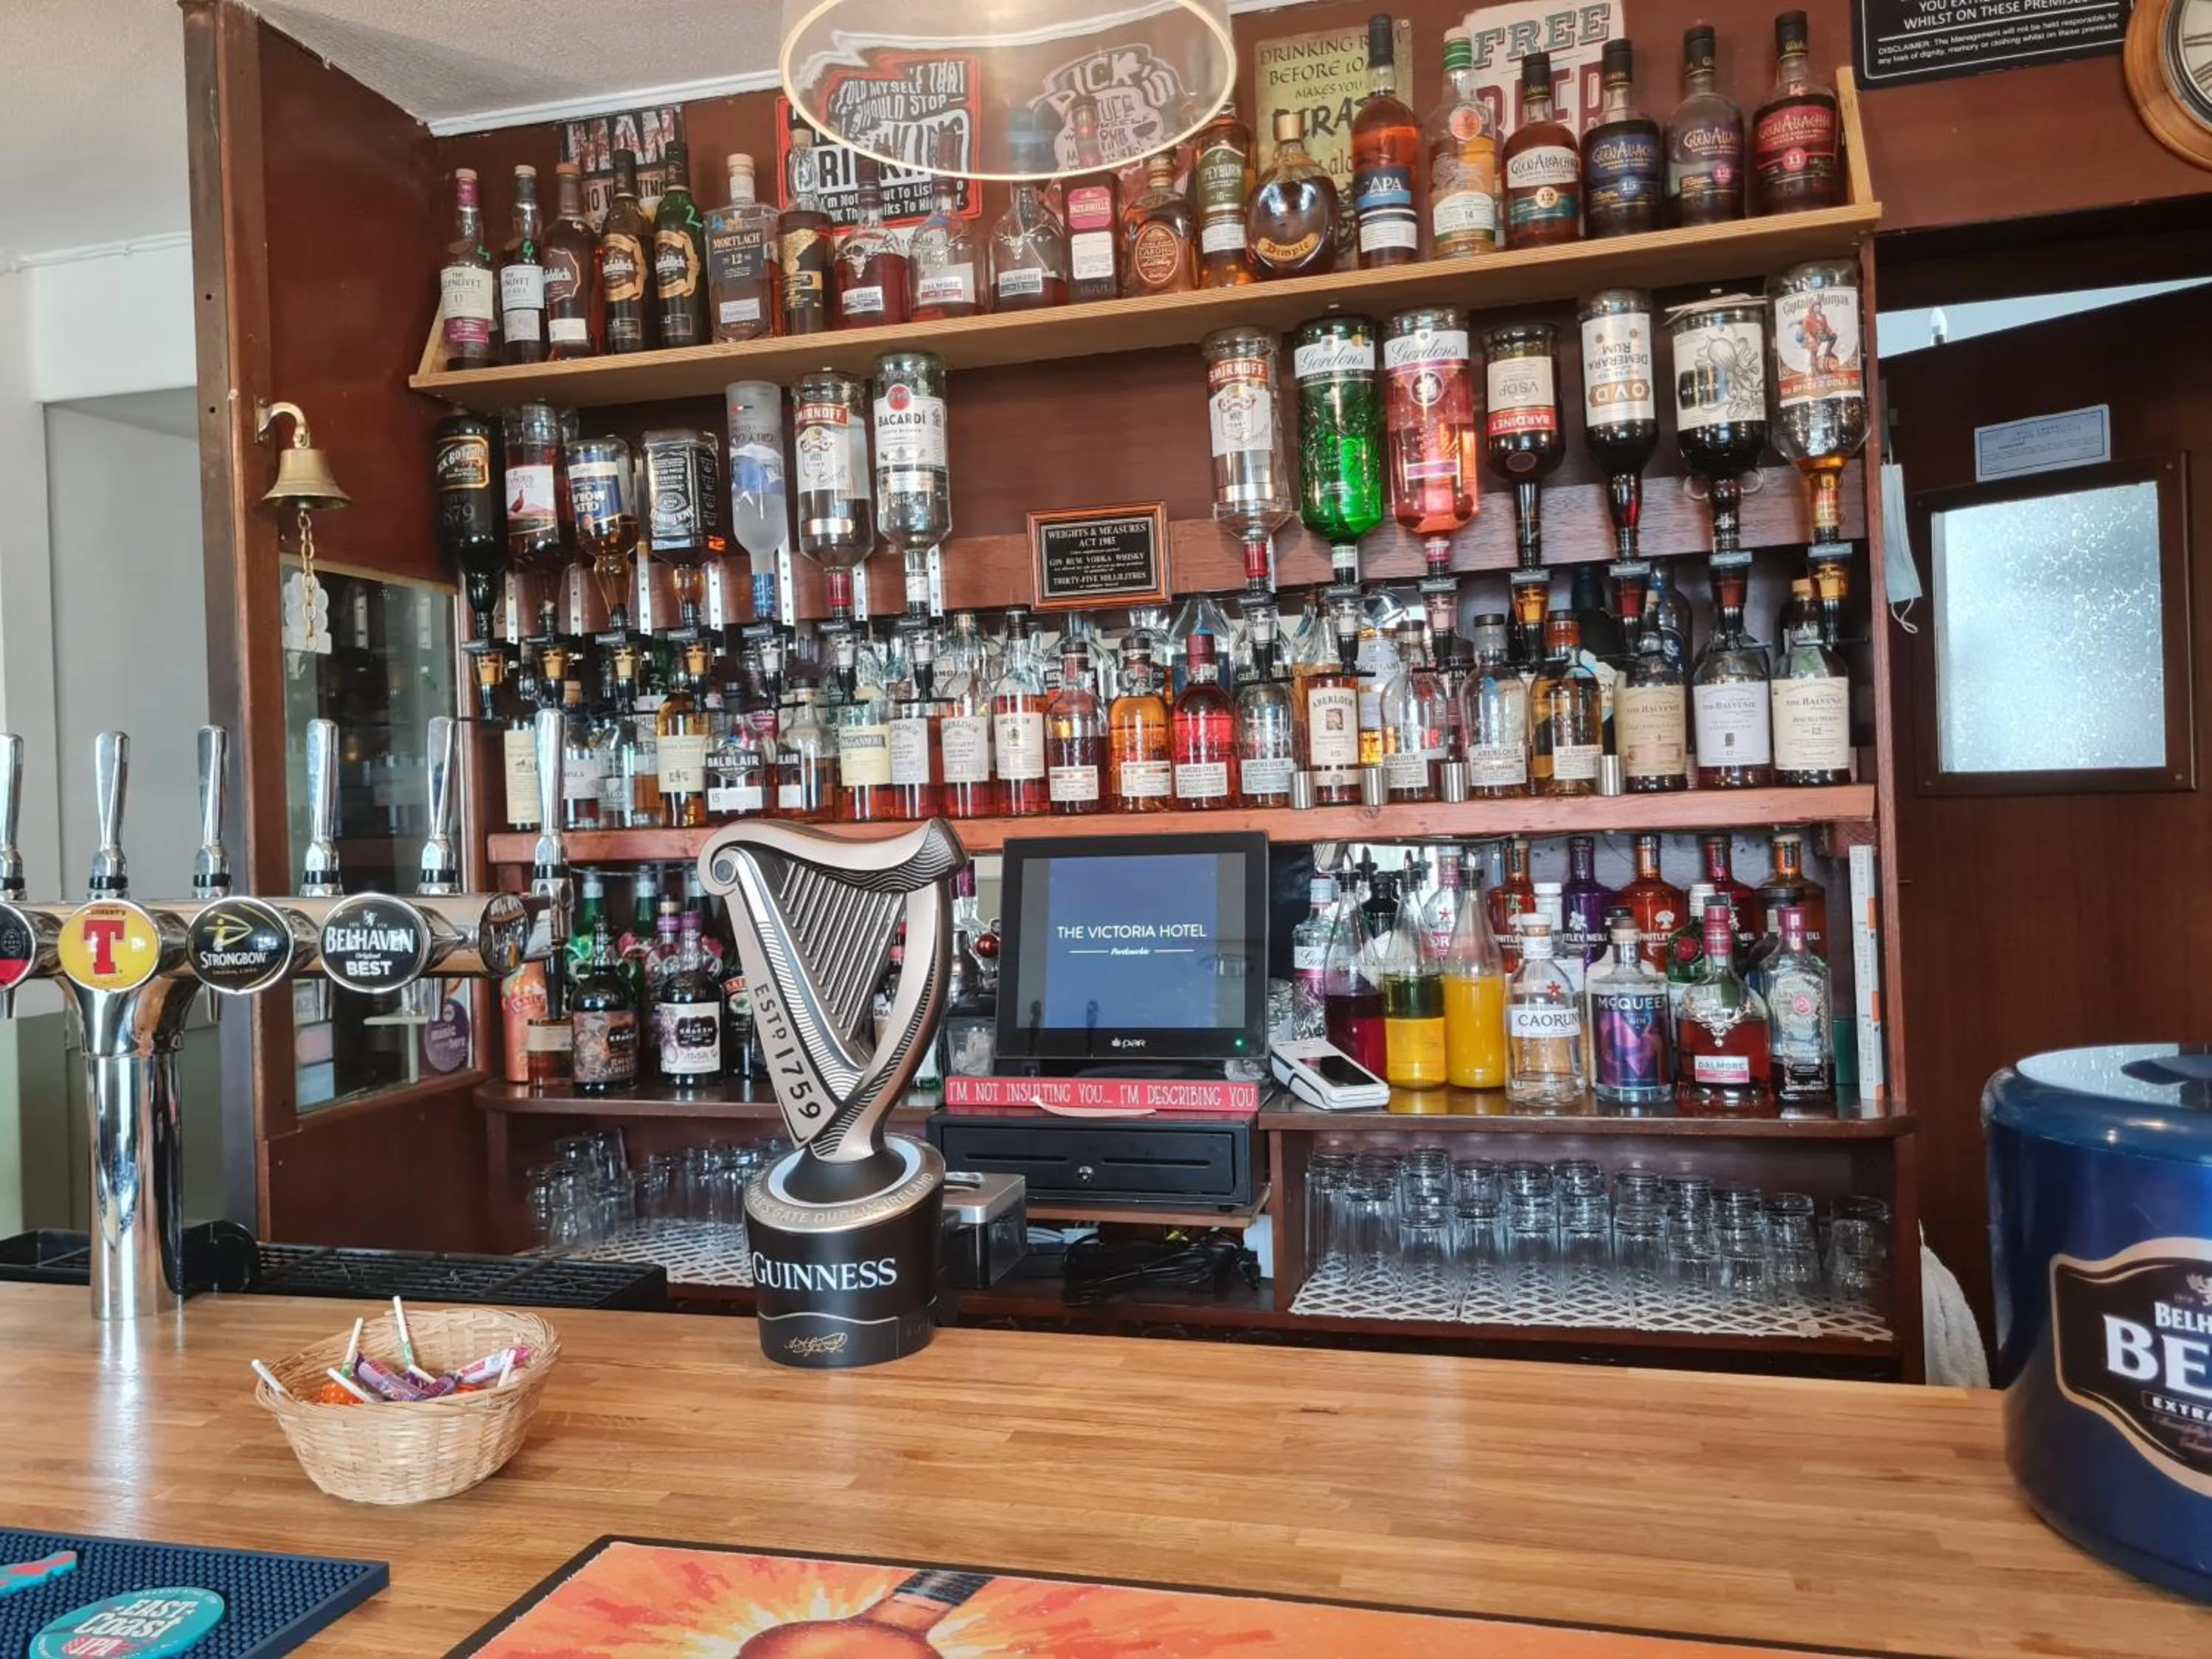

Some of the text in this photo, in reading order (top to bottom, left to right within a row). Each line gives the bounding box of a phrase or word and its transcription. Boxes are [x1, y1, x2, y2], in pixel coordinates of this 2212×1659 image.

[1904, 11, 1953, 29] WHILST
[1956, 8, 1978, 21] ON
[1981, 1, 2021, 16] THESE
[1919, 0, 1947, 12] YOU
[1474, 3, 1611, 66] FREE
[1260, 37, 1353, 66] DRINKING
[1269, 60, 1342, 86] BEFORE
[869, 80, 922, 97] MYSELF
[1295, 80, 1363, 100] MAKES YOU
[909, 94, 947, 116] STOP
[1622, 179, 1637, 191] 15
[712, 232, 762, 249] MORTLACH
[1262, 234, 1315, 258] Dimple
[731, 253, 743, 265] 12
[1816, 293, 1850, 307] Morgan
[1298, 346, 1366, 369] Gordon's
[1392, 340, 1459, 364] Gordon's
[1601, 341, 1632, 355] RUM
[1587, 352, 1649, 370] DEMERARA
[1208, 366, 1265, 383] SMIRNOFF
[1498, 380, 1539, 398] VSOP
[1048, 528, 1088, 540] WEIGHTS
[1099, 523, 1147, 536] MEASURES
[1079, 538, 1096, 548] ACT
[1049, 552, 1144, 567] GIN RUM VODKA WHISKY
[706, 754, 759, 768] BALBLAIR
[325, 926, 414, 954] BELHAVEN
[1057, 923, 1207, 939] THE VICTORIA HOTEL
[83, 919, 125, 975] T
[200, 950, 268, 969] STRONGBOW
[345, 960, 393, 977] BEST
[1697, 1060, 1747, 1071] DALMORE
[774, 1047, 822, 1119] 1759
[949, 1082, 967, 1101] I'M
[975, 1083, 999, 1102] NOT
[1006, 1082, 1071, 1103] INSULTING
[1120, 1085, 1140, 1105] I'M
[1147, 1085, 1222, 1106] DESCRIBING
[1228, 1087, 1255, 1107] YOU
[773, 1206, 810, 1223] GATE
[813, 1202, 880, 1223] DUBLIN
[883, 1172, 935, 1210] IRELAND
[751, 1251, 898, 1292] GUINNESS
[121, 1599, 199, 1618] EAST
[66, 1637, 125, 1657] IPA
